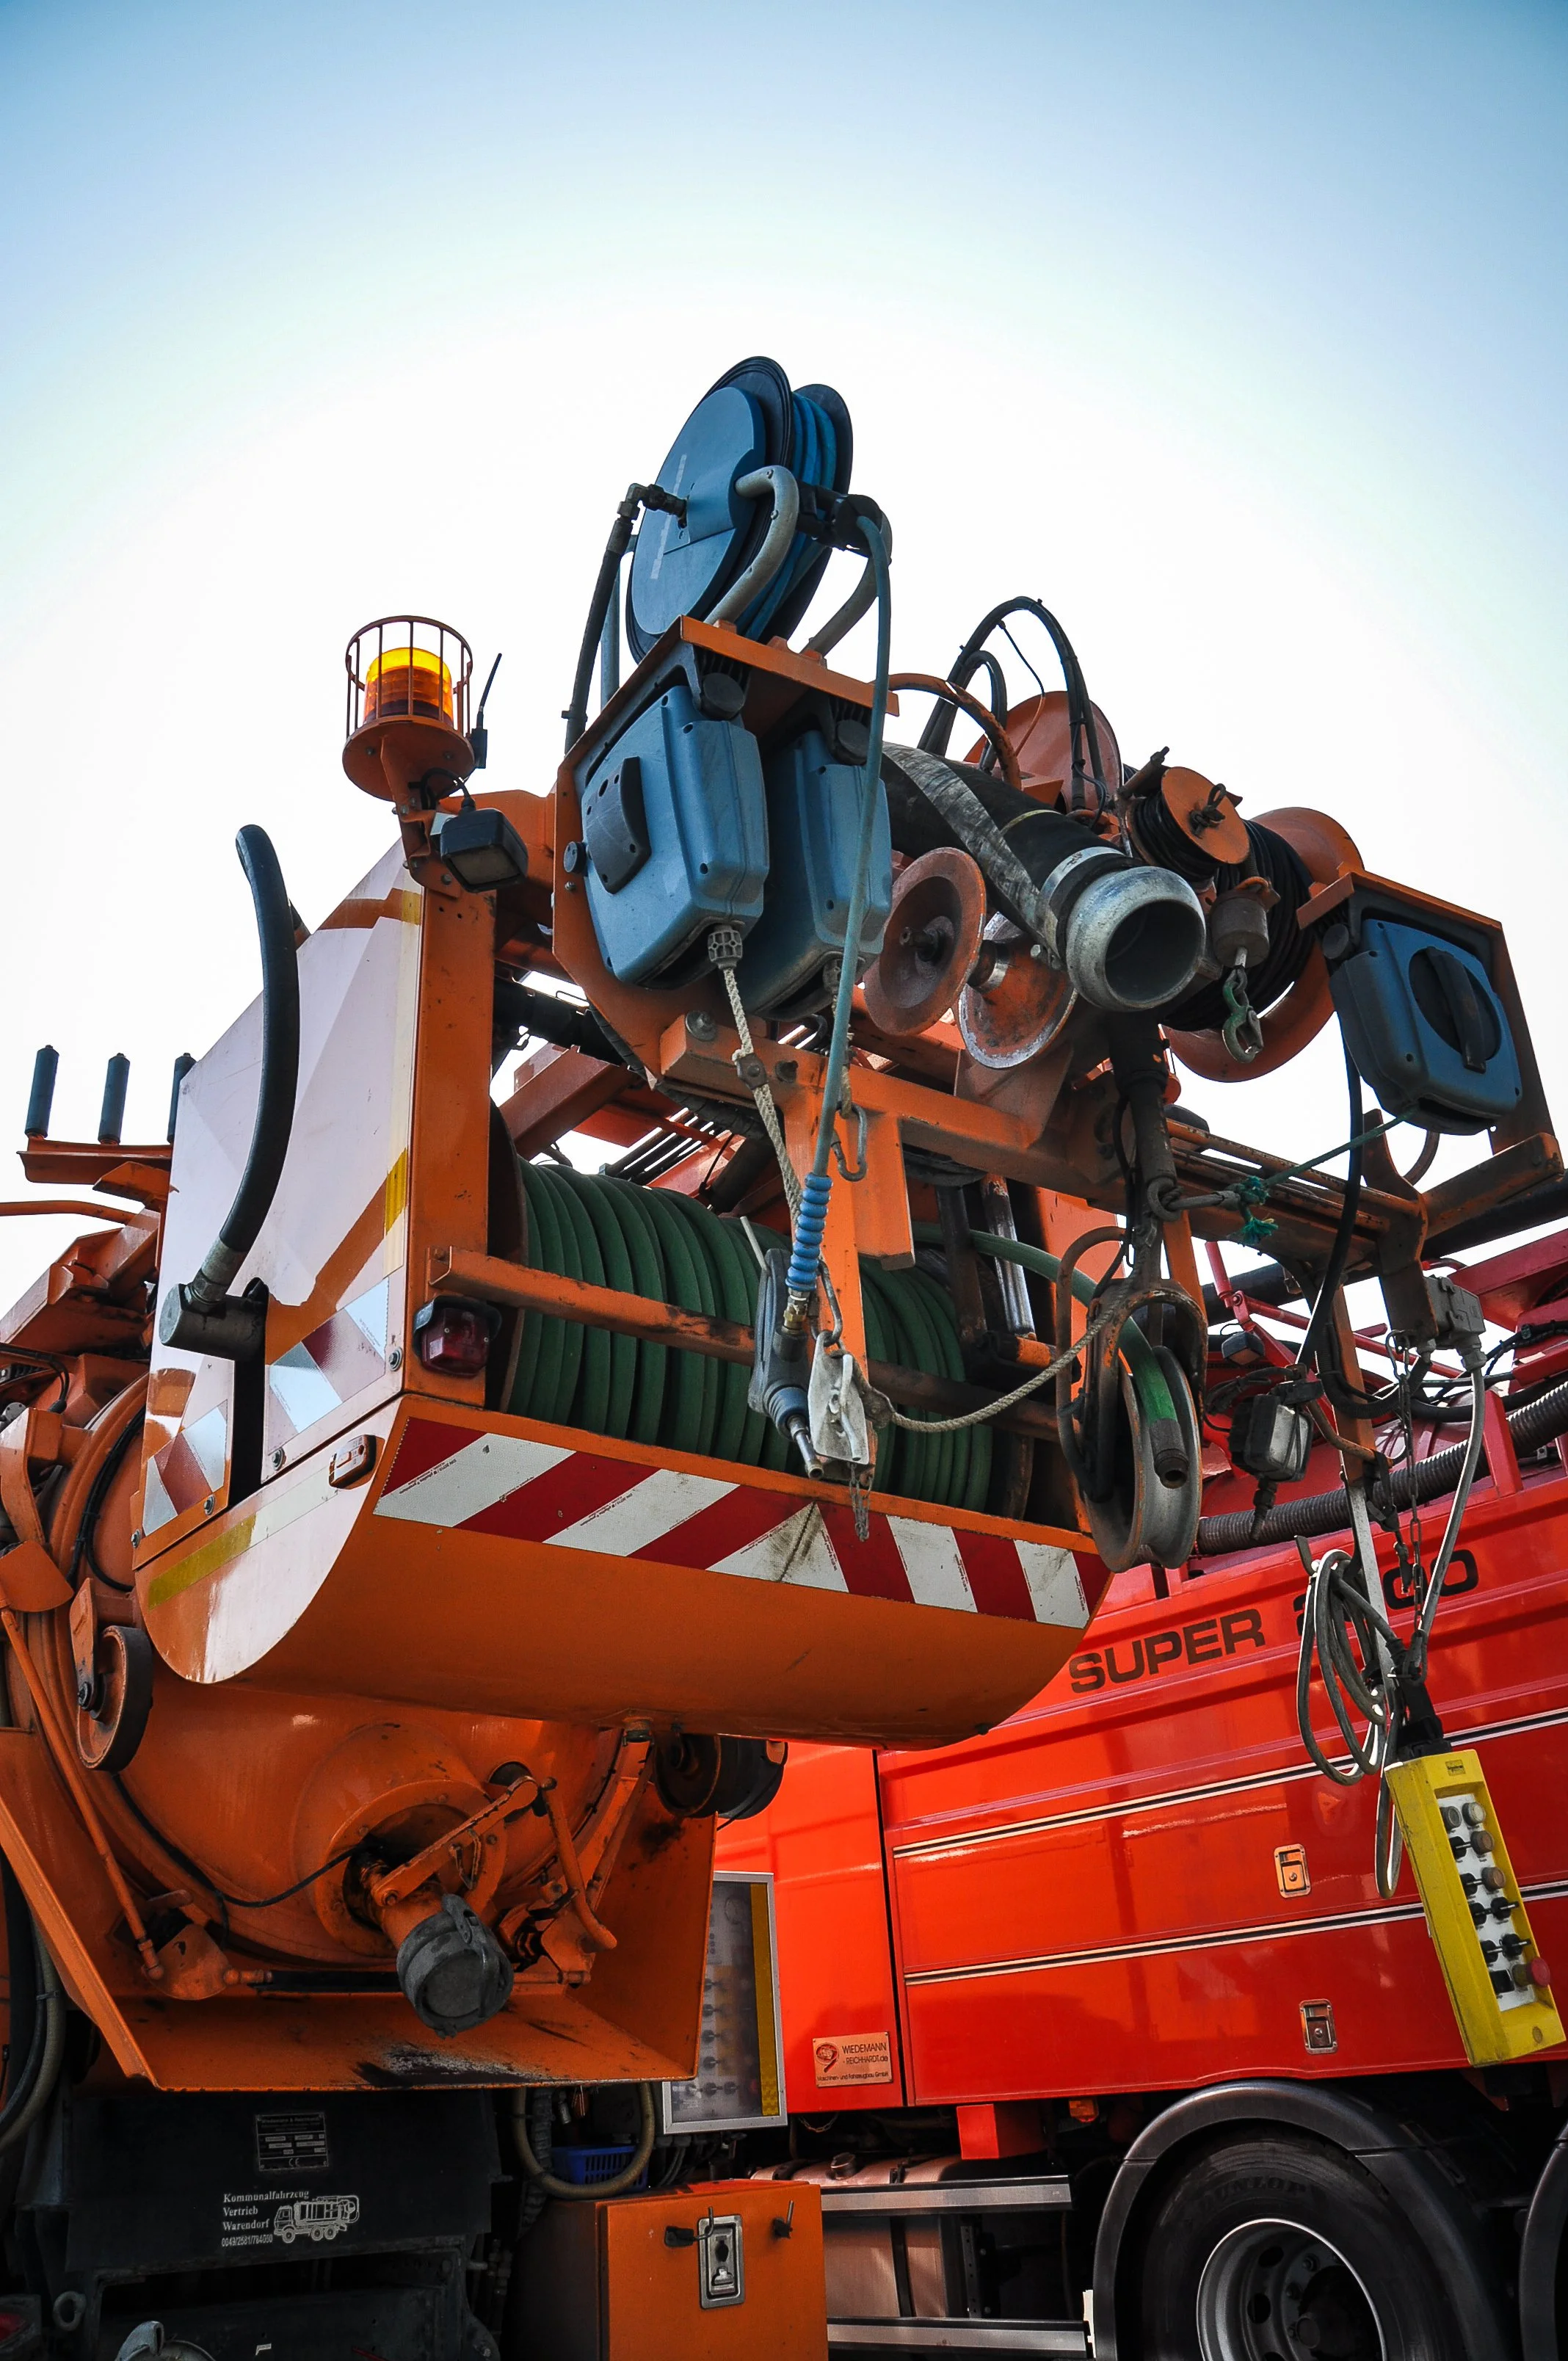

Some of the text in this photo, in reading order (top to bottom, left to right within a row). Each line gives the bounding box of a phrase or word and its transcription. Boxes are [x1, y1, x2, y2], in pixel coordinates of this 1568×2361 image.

[1069, 1549, 1479, 1693] SUPER 00
[842, 2042, 887, 2054] WIEDEMANN
[223, 2190, 309, 2203] Kommunalfahrzeug
[223, 2205, 258, 2216] Vertrieb
[222, 2219, 269, 2231] Warendorf
